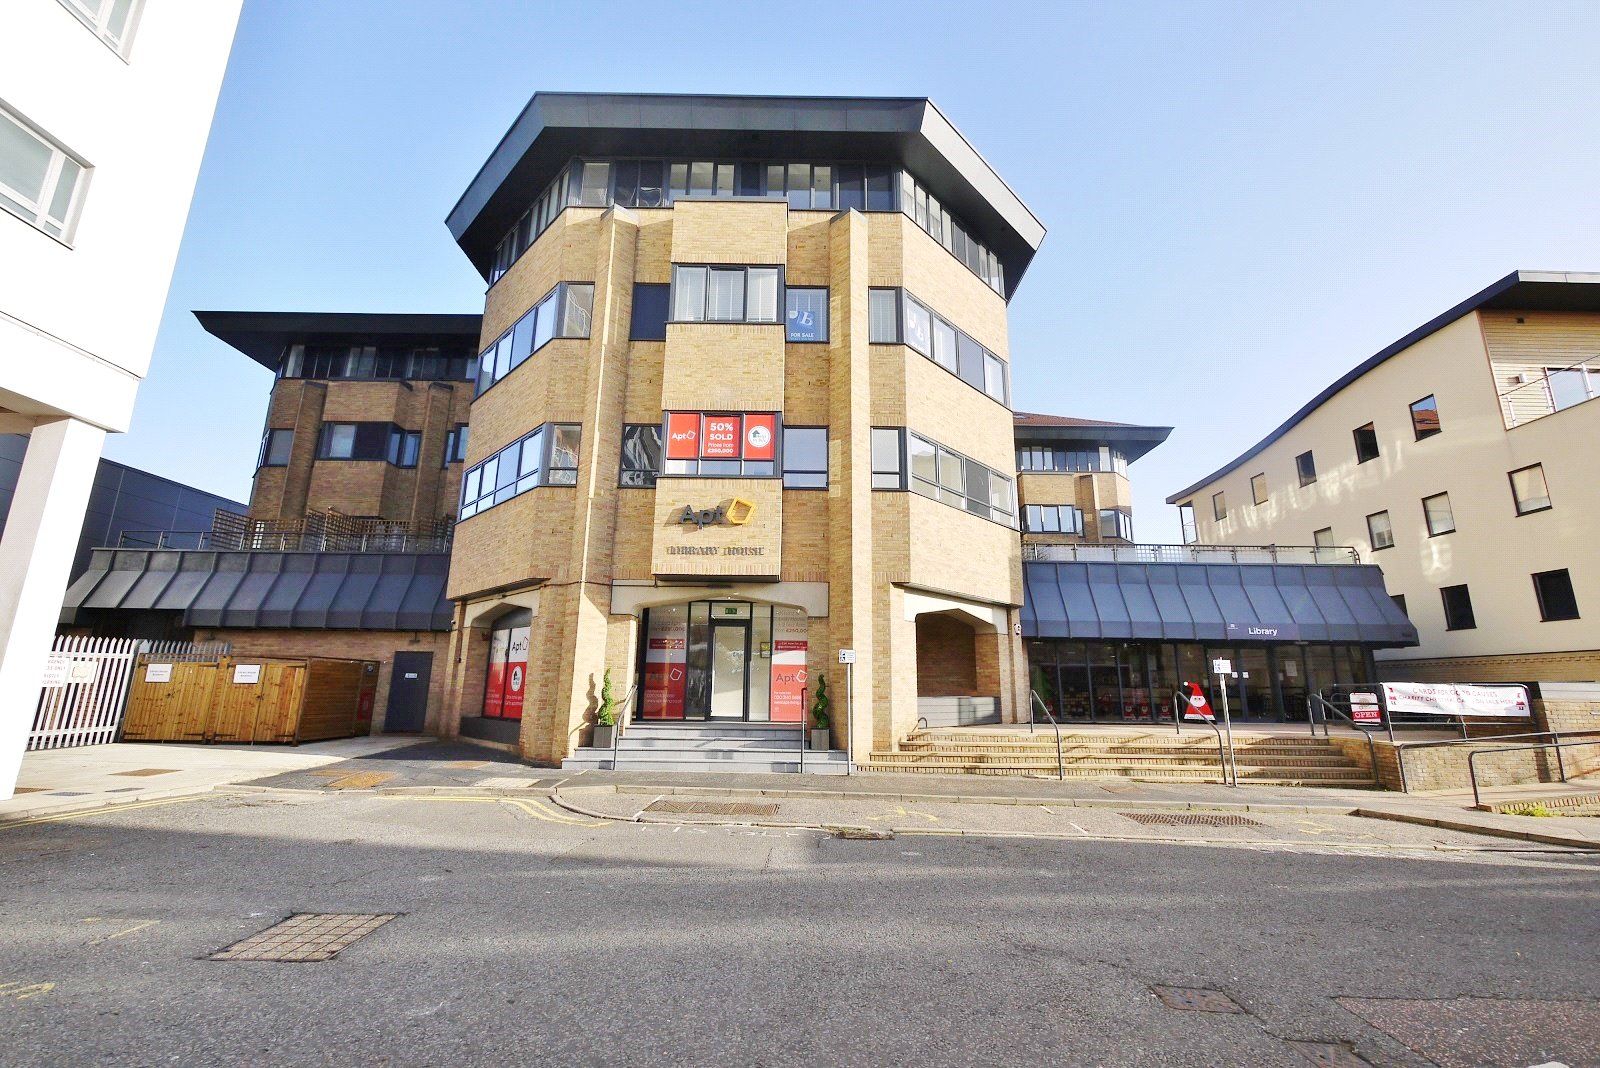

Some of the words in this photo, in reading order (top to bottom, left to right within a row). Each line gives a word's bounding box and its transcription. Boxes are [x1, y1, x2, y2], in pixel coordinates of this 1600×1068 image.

[710, 422, 733, 431] 50%
[672, 432, 687, 441] Apt
[709, 433, 733, 441] SOLD
[680, 504, 723, 530] Apt
[666, 545, 719, 556] LIBRARY
[722, 546, 765, 556] HOUSE
[1248, 627, 1277, 636] Library
[512, 642, 522, 654] Apt
[776, 673, 795, 685] Apt
[1354, 711, 1377, 719] OPEN
